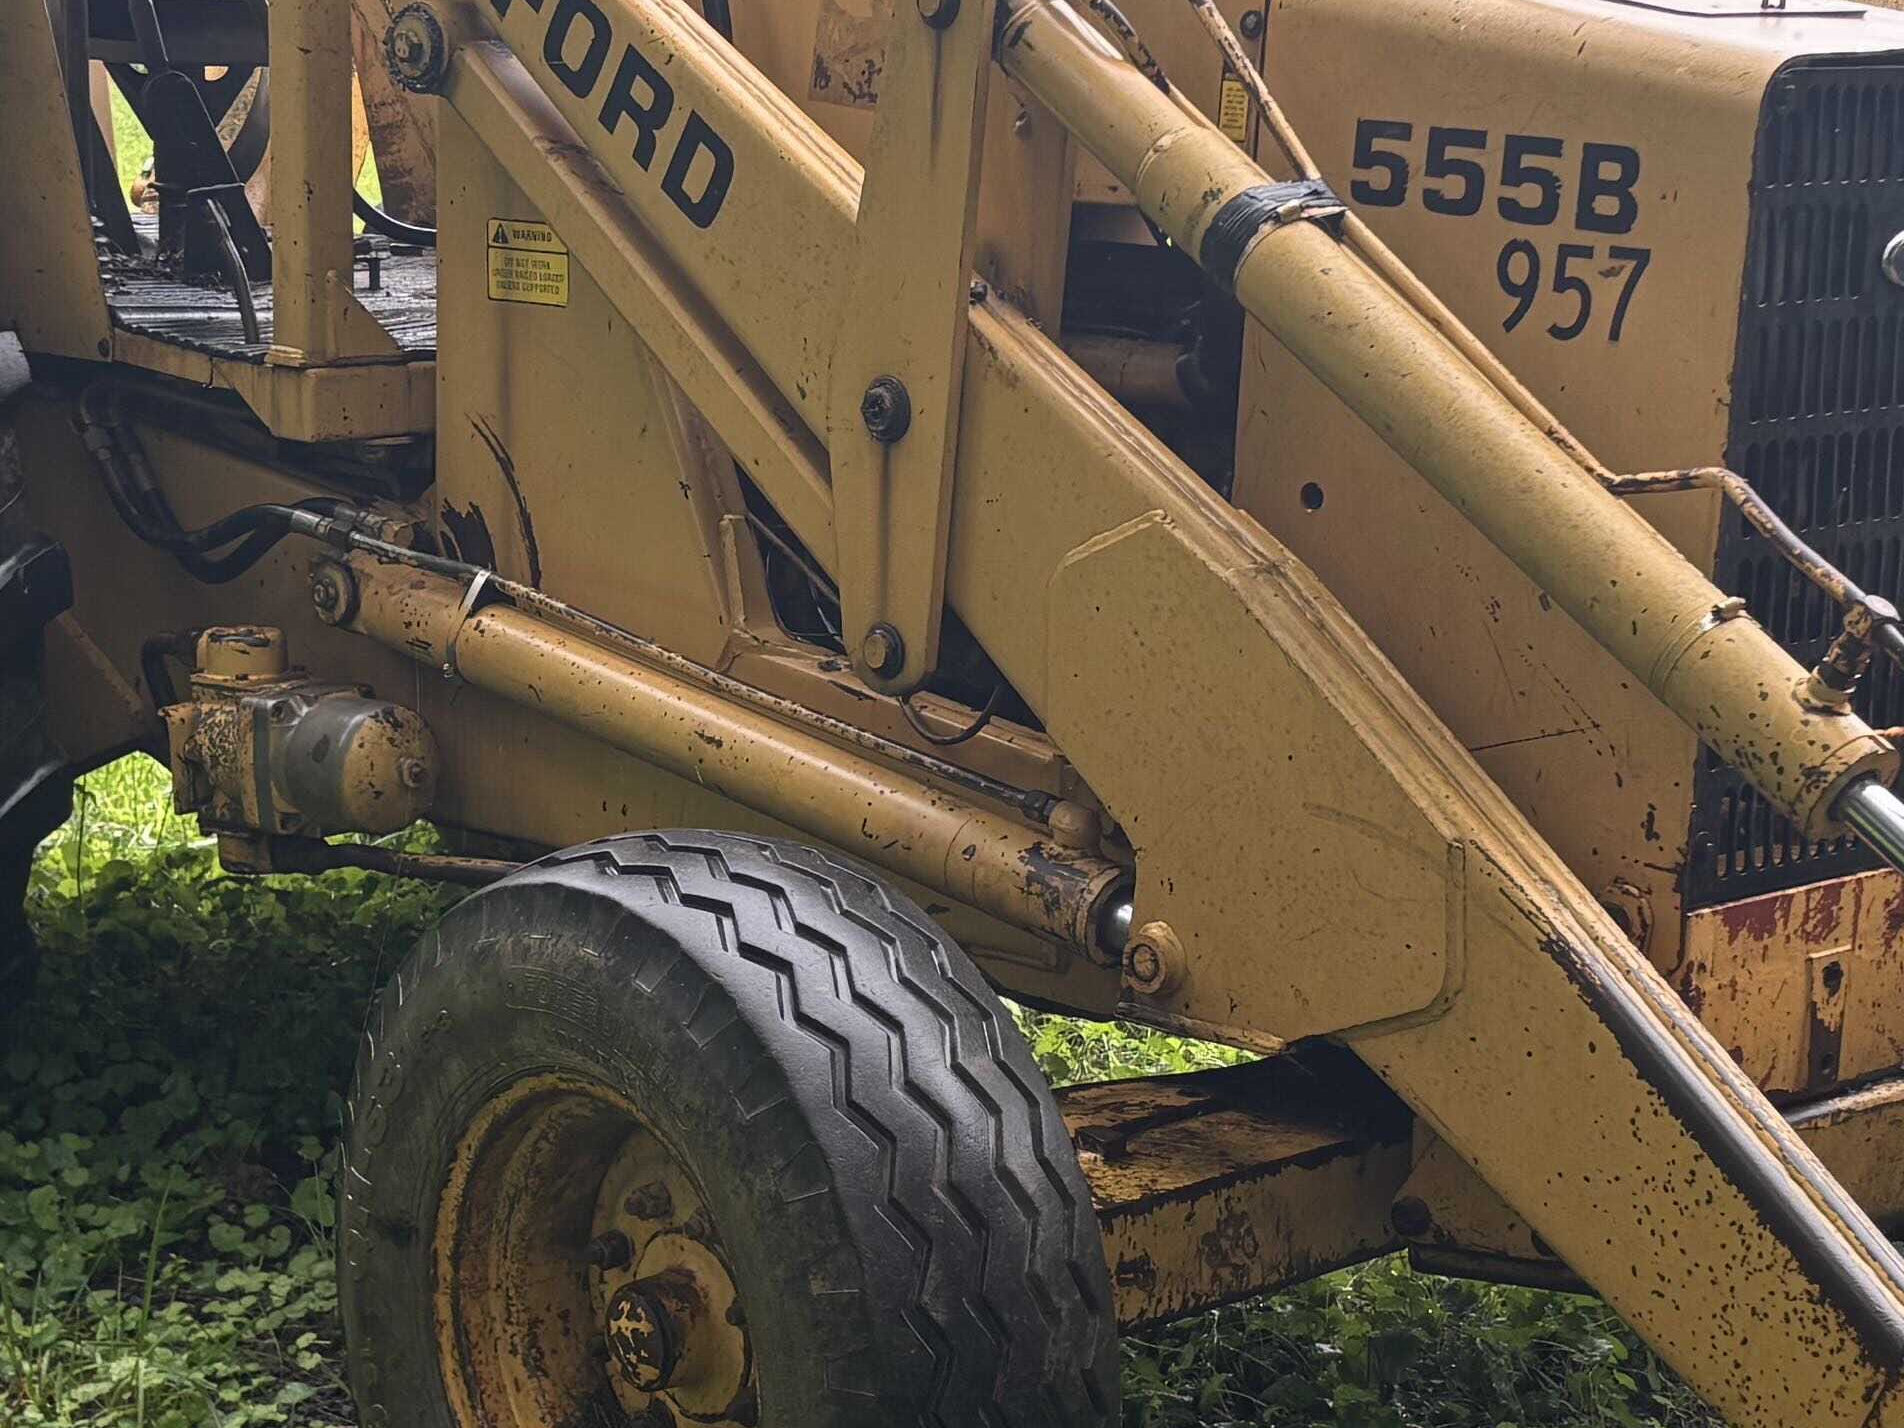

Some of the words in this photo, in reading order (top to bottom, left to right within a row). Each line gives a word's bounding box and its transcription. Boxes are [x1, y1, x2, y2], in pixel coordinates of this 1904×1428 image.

[1350, 118, 1640, 234] 555B
[512, 229, 553, 243] WARNING
[1497, 238, 1652, 342] 957
